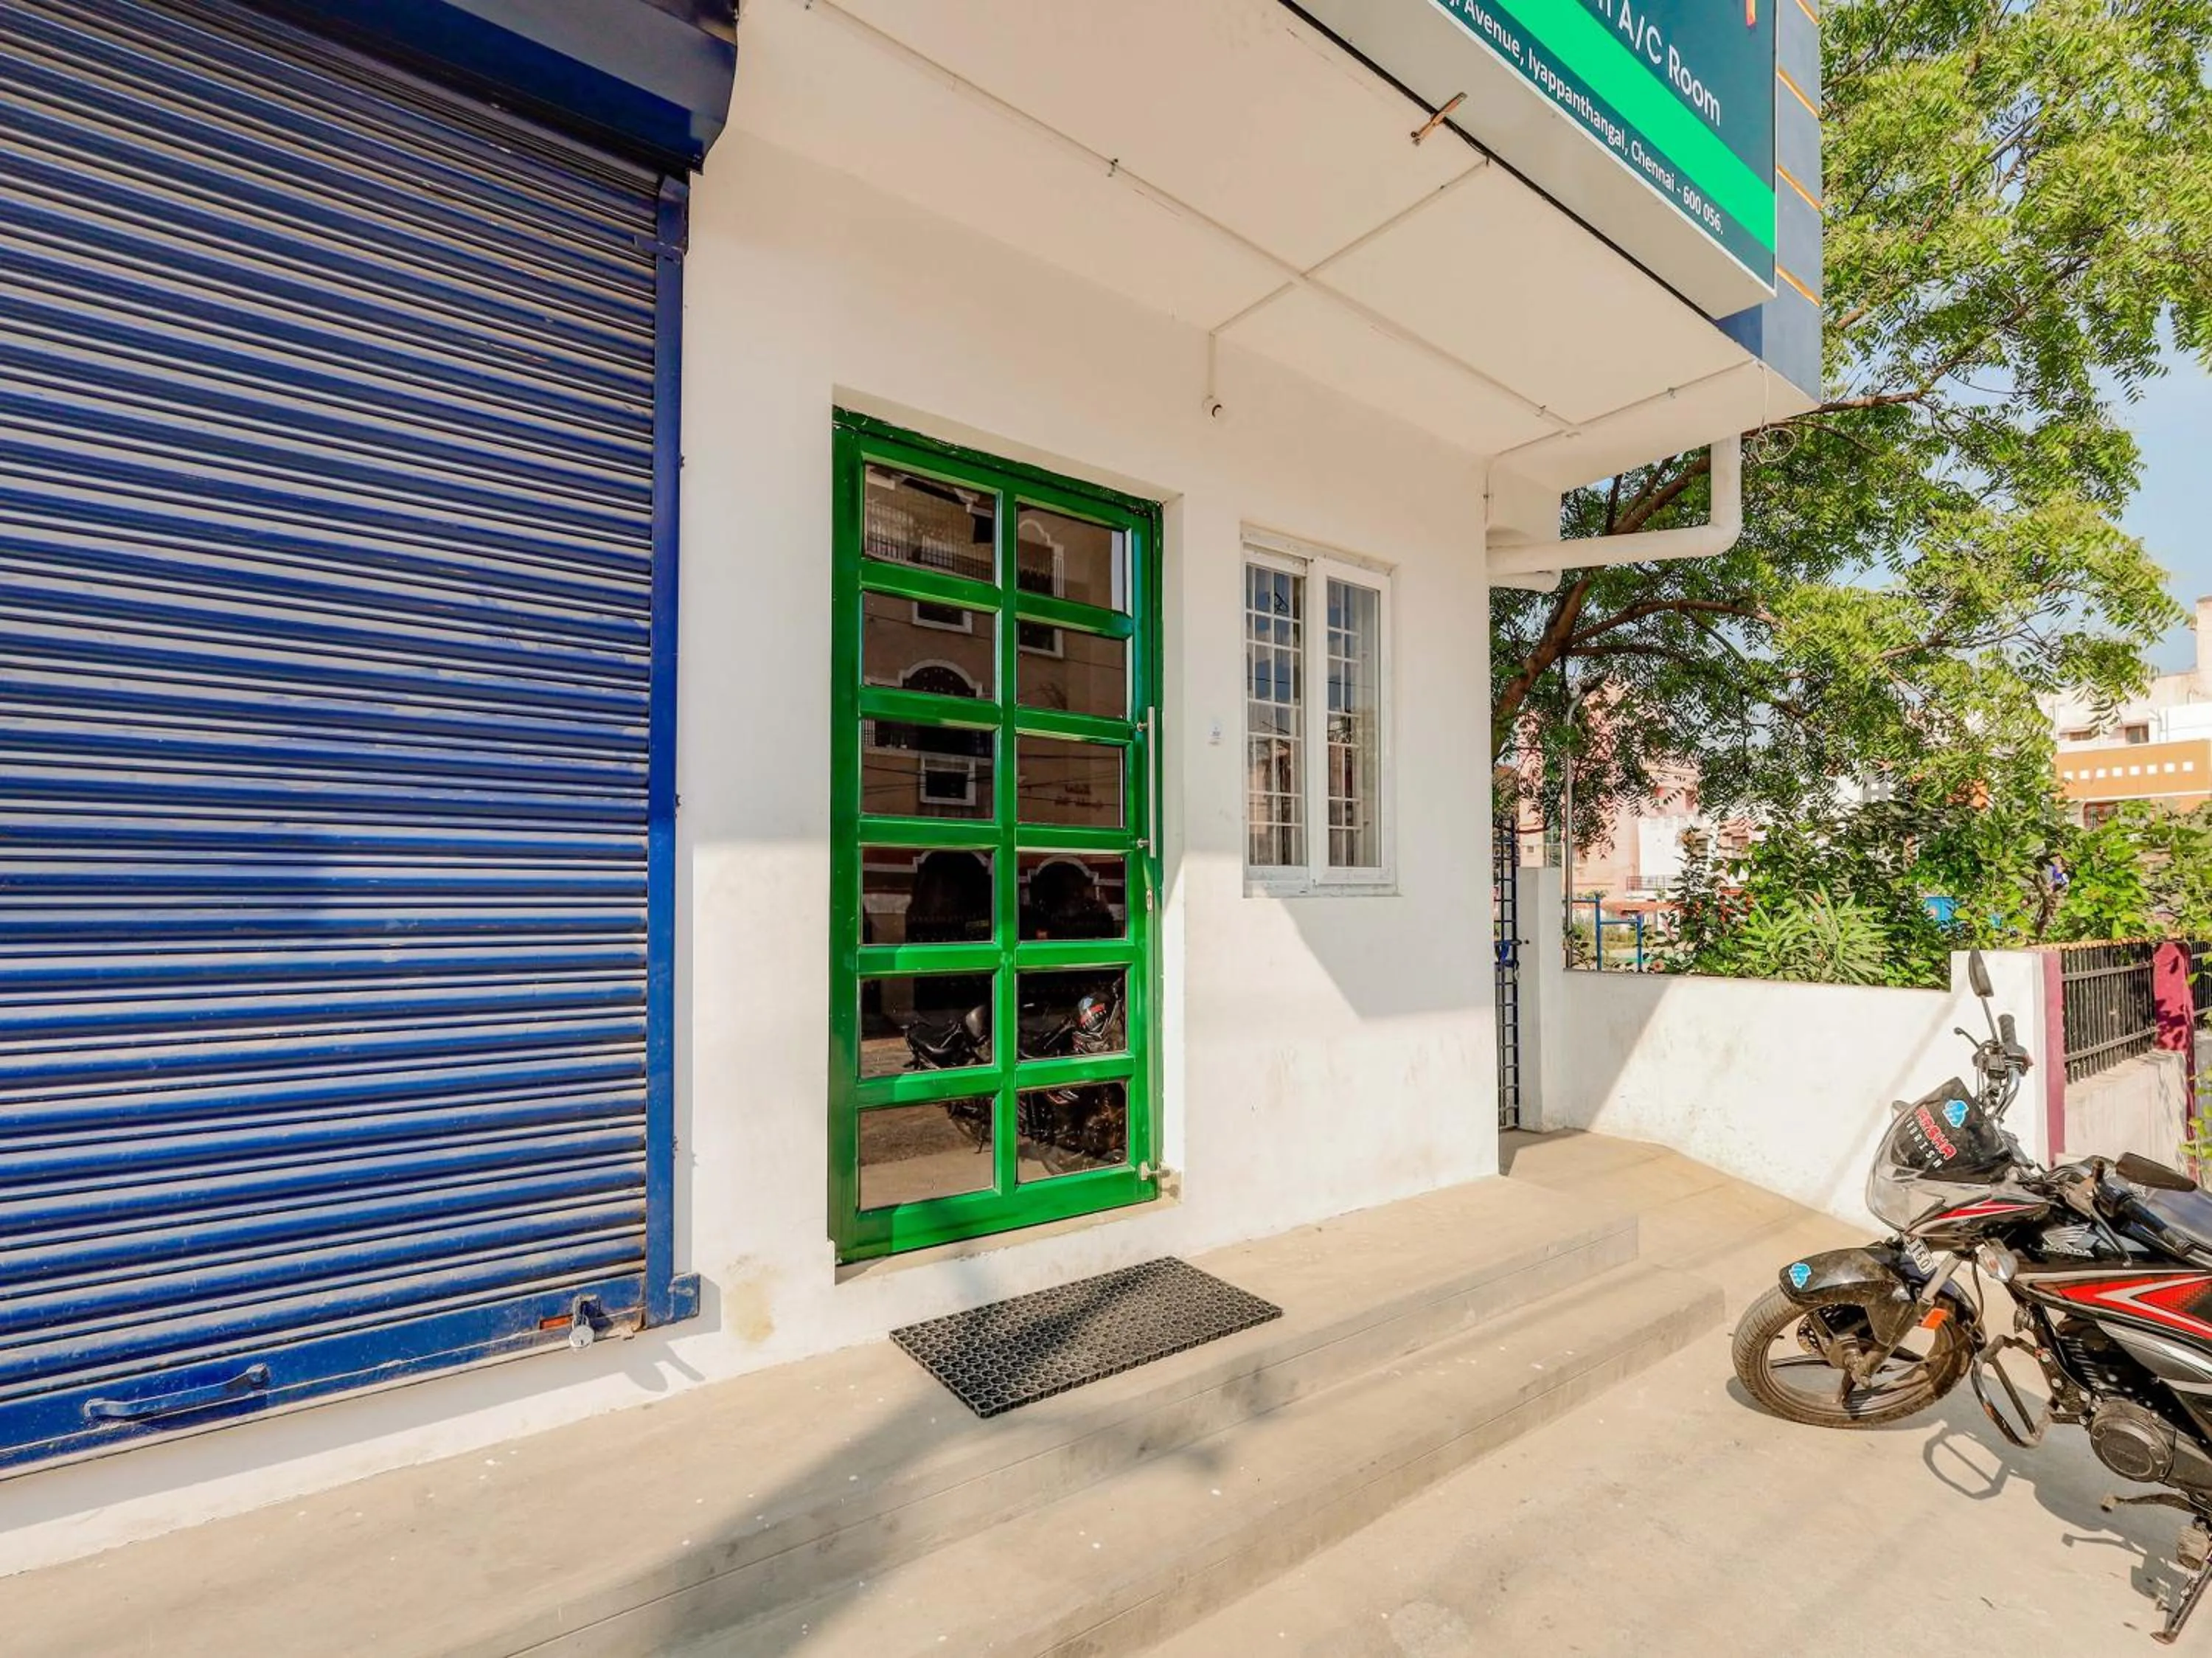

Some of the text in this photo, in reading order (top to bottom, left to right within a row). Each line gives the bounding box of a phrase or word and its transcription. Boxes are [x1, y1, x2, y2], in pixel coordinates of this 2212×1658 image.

[1464, 0, 1525, 66] Avenue,
[1528, 47, 1629, 156] Iyappanthangal,
[1631, 139, 1675, 192] Chennai
[1683, 185, 1701, 215] 600
[1703, 203, 1723, 235] 056.
[1618, 0, 1720, 127] A/C Room
